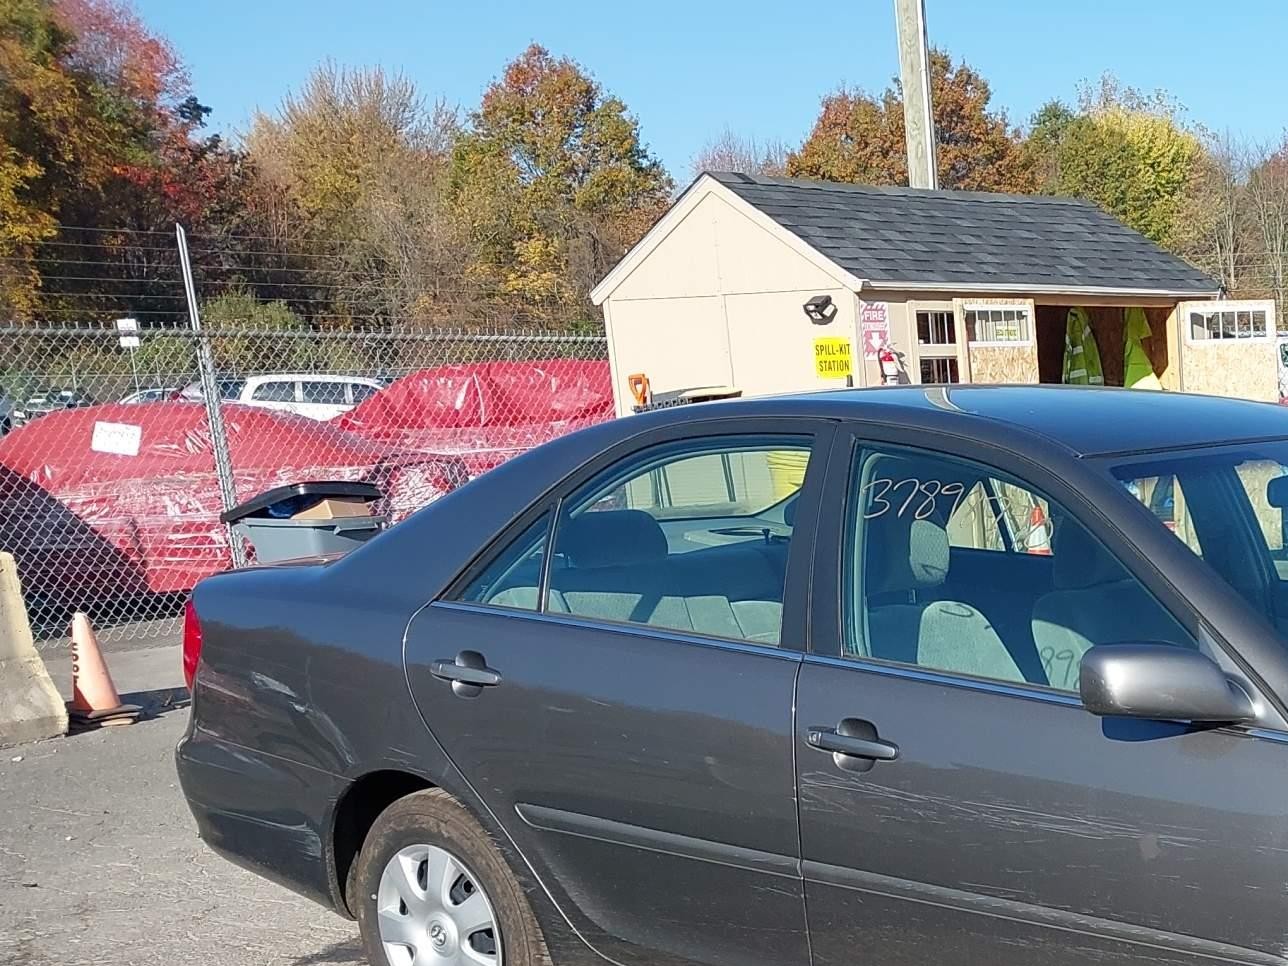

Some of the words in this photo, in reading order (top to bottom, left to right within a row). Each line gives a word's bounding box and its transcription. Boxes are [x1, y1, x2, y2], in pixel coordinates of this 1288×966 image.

[864, 310, 884, 321] FIRE
[815, 343, 851, 356] SPILL-KIT
[818, 359, 850, 372] STATION
